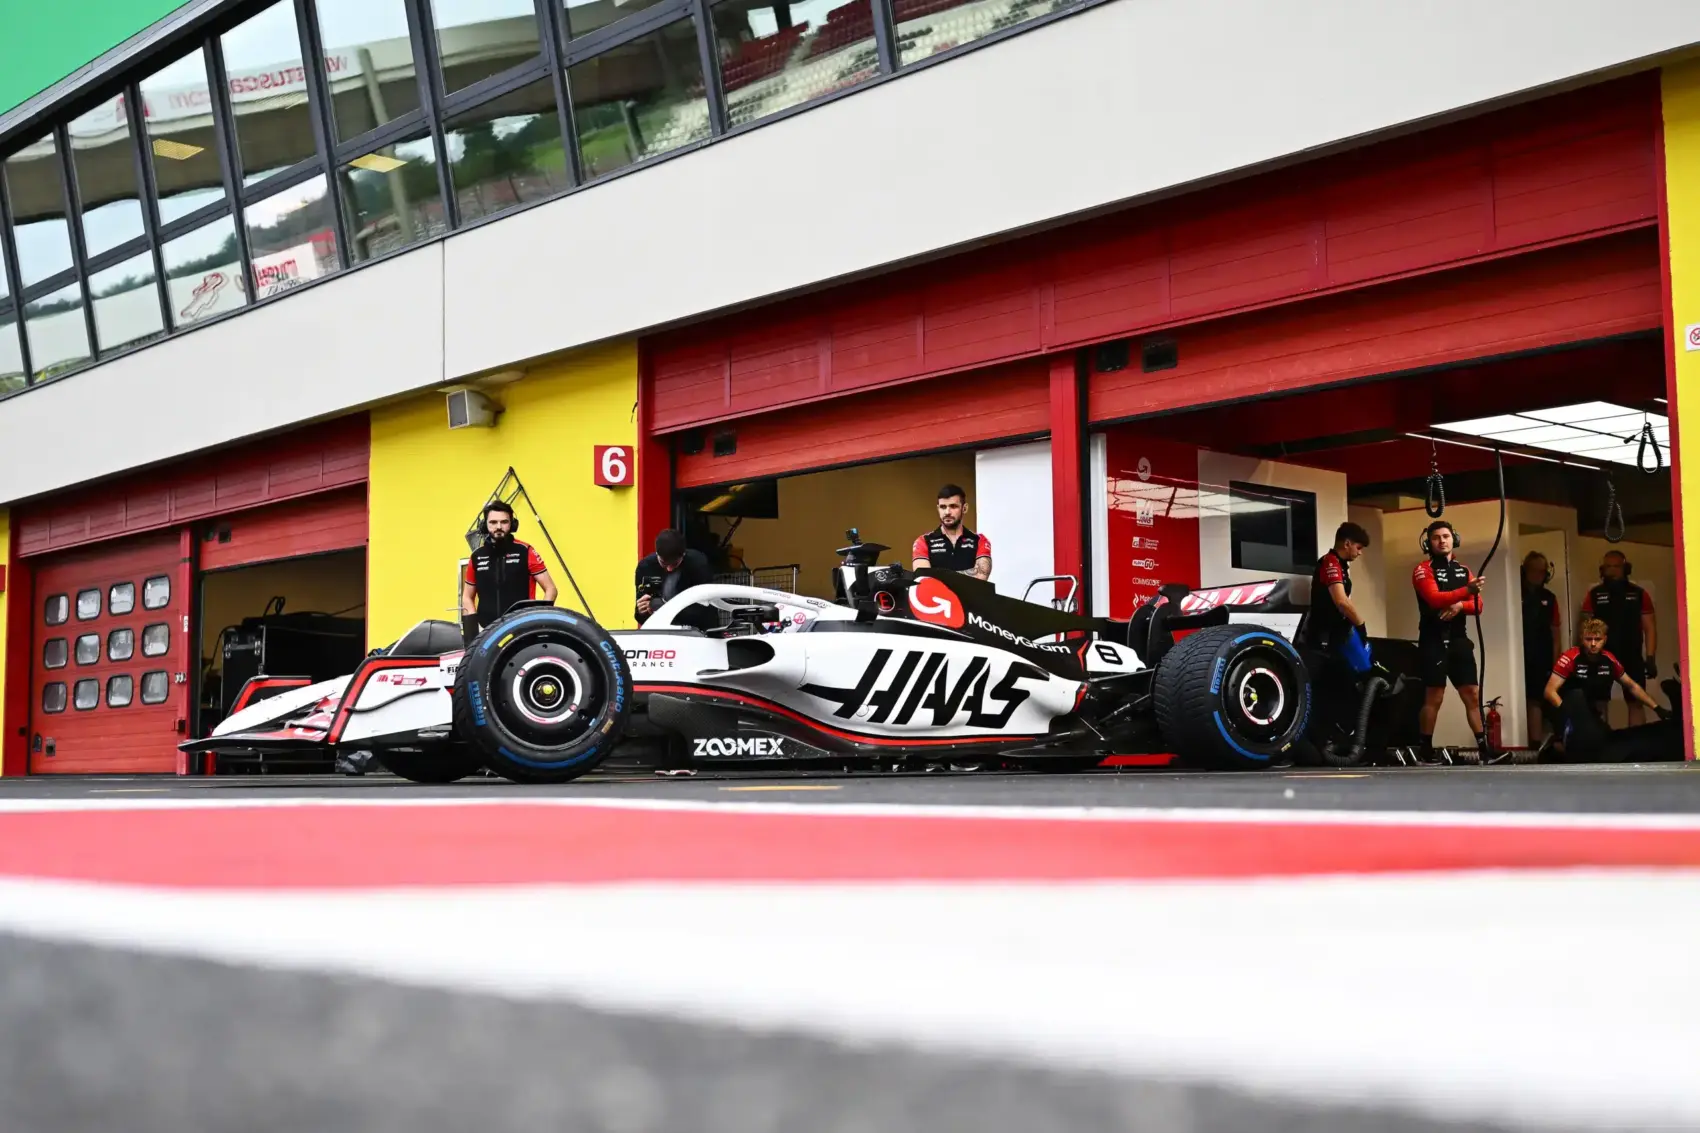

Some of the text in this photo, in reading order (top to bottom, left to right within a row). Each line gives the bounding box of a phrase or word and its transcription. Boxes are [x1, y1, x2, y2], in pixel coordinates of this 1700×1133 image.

[602, 446, 627, 483] 6
[967, 611, 1072, 655] MoneyGram
[1094, 643, 1124, 666] 8
[797, 648, 1051, 730] HAAS
[693, 737, 786, 757] ZOOMEX
